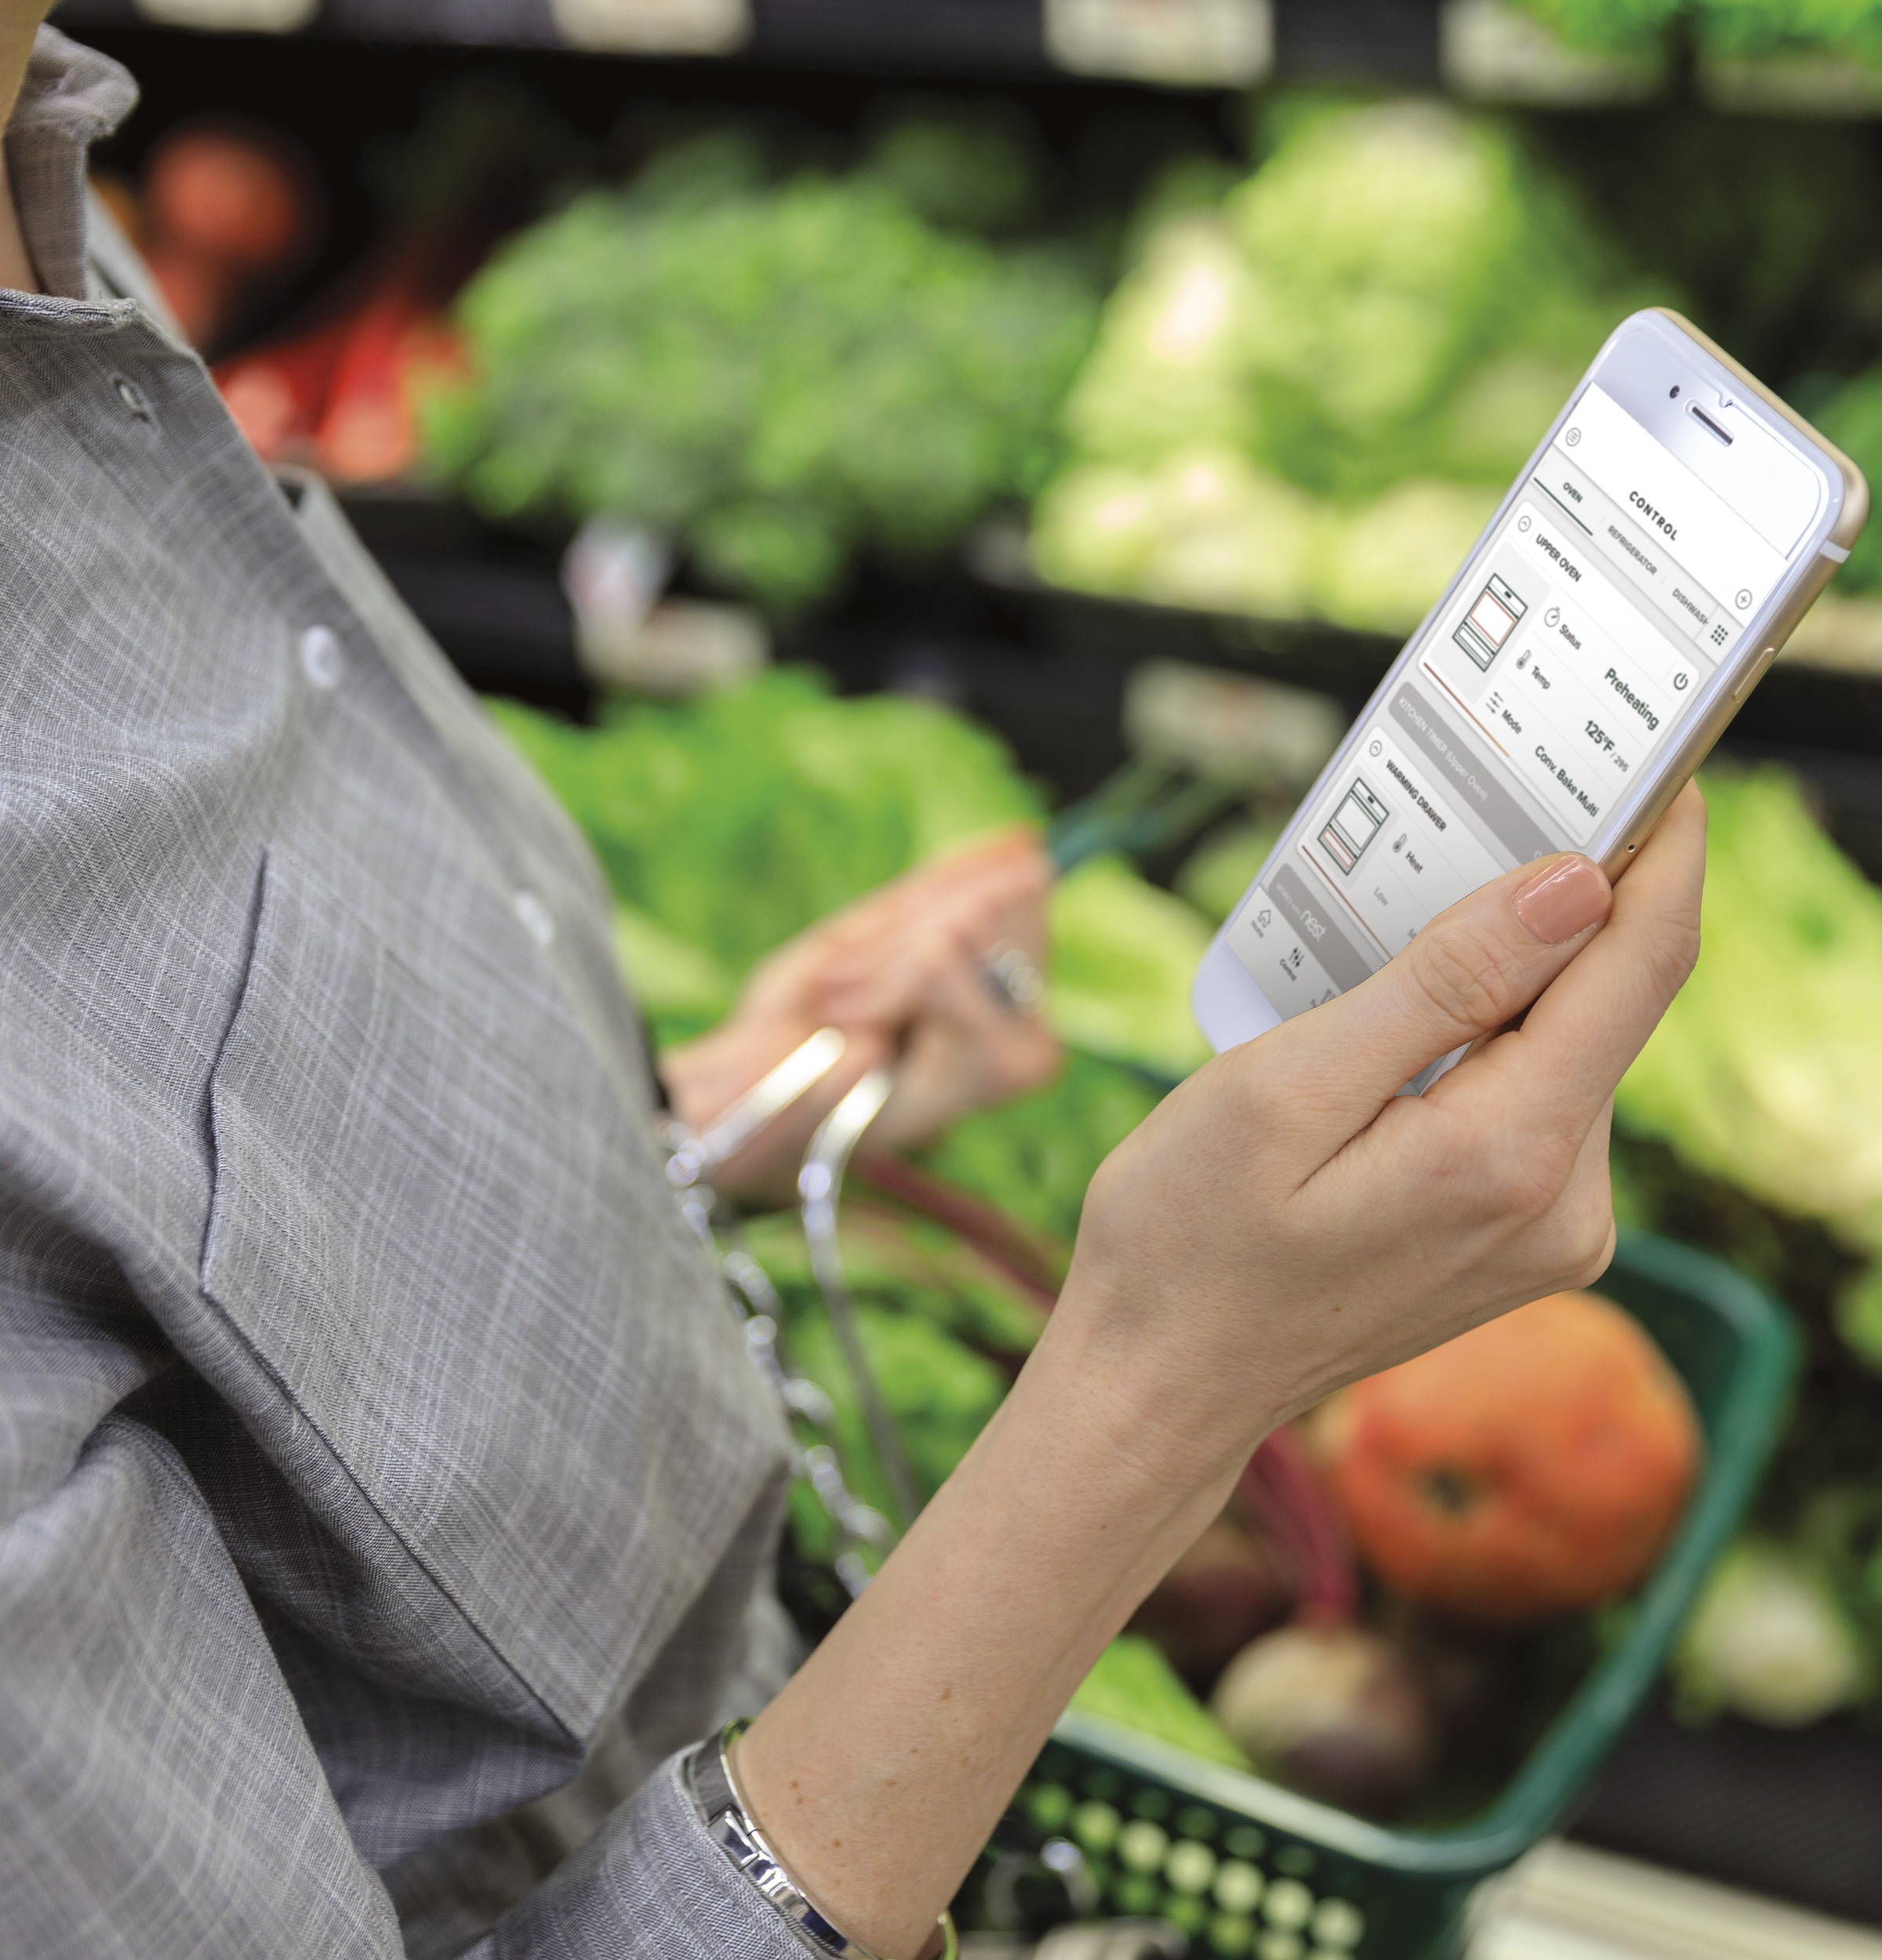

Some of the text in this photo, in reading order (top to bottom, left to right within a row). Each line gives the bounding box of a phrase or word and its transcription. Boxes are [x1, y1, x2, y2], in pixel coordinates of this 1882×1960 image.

[1563, 481, 1583, 503] OVEN
[1608, 524, 1657, 576] REFRIGERATOR
[1629, 490, 1678, 541] CONTROL
[1535, 533, 1582, 583] UPPER OVEN
[1531, 666, 1550, 690] Temp
[1584, 720, 1615, 753] 125°F
[1559, 623, 1659, 731] Status Preheating
[1398, 695, 1489, 802] KITCHEN TIMER (Upper Oven)
[1501, 709, 1600, 818] Mode Conv. Bake Multi
[1386, 758, 1447, 833] WARMING DRAWER
[1405, 851, 1423, 874] Heat
[1300, 910, 1326, 942] nest
[1279, 958, 1297, 982] Control
